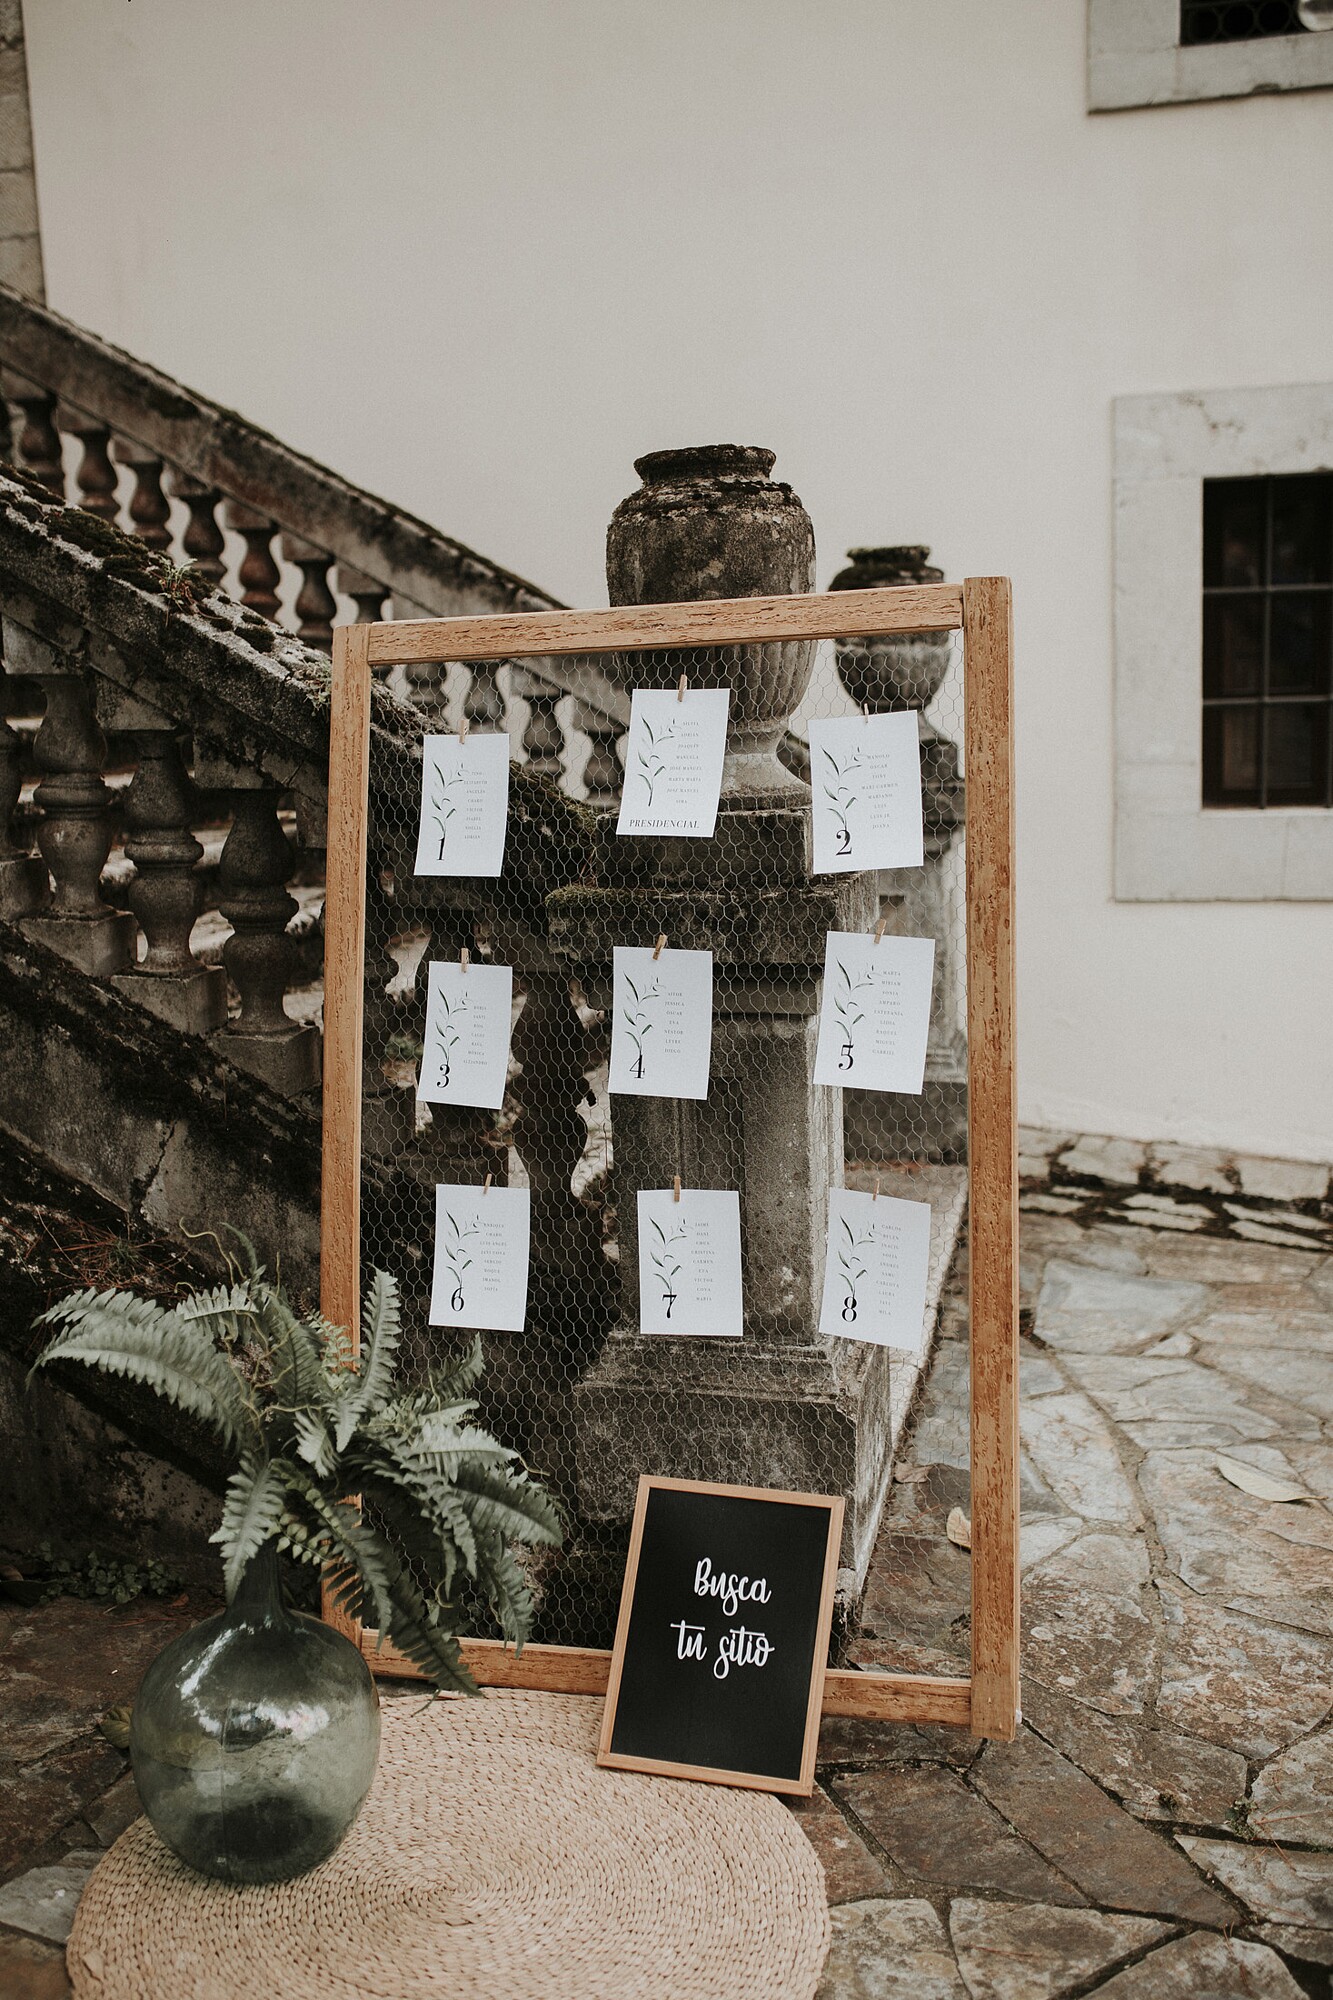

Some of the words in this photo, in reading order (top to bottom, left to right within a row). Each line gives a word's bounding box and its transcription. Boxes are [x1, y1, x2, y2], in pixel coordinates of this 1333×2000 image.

[629, 819, 699, 828] PRESIDENCIAL
[437, 837, 445, 861] 1
[836, 830, 852, 855] 2
[629, 1055, 645, 1079] 4
[839, 1044, 854, 1070] 5
[437, 1064, 450, 1088] 3
[451, 1287, 464, 1312] 6
[662, 1294, 677, 1318] 7
[842, 1296, 857, 1322] 8
[694, 1557, 772, 1616] Busca
[670, 1619, 708, 1660] tu
[714, 1625, 776, 1680] sitio
